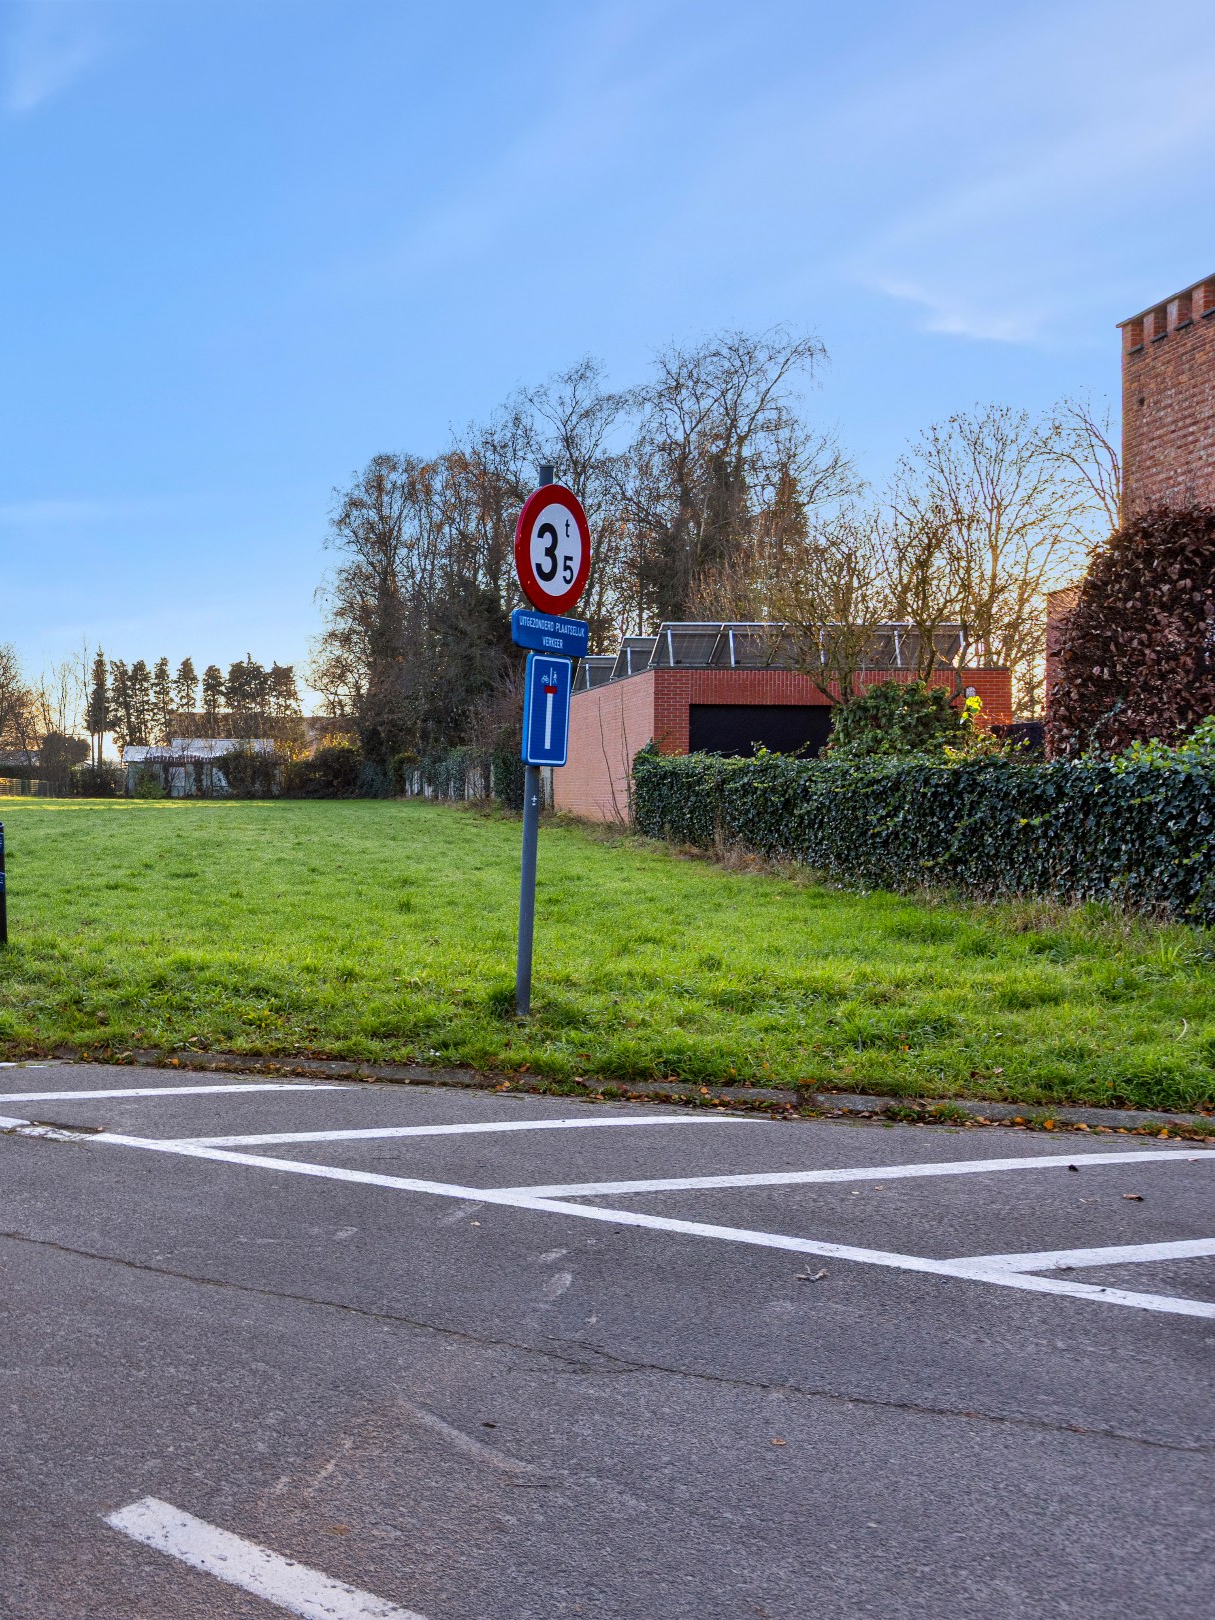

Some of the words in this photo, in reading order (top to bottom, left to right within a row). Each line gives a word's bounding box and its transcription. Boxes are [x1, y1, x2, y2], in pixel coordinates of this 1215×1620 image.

[519, 616, 554, 632] UITGEZONDERD
[555, 623, 585, 638] PLAATSELIJK
[542, 636, 564, 649] VERKEER
